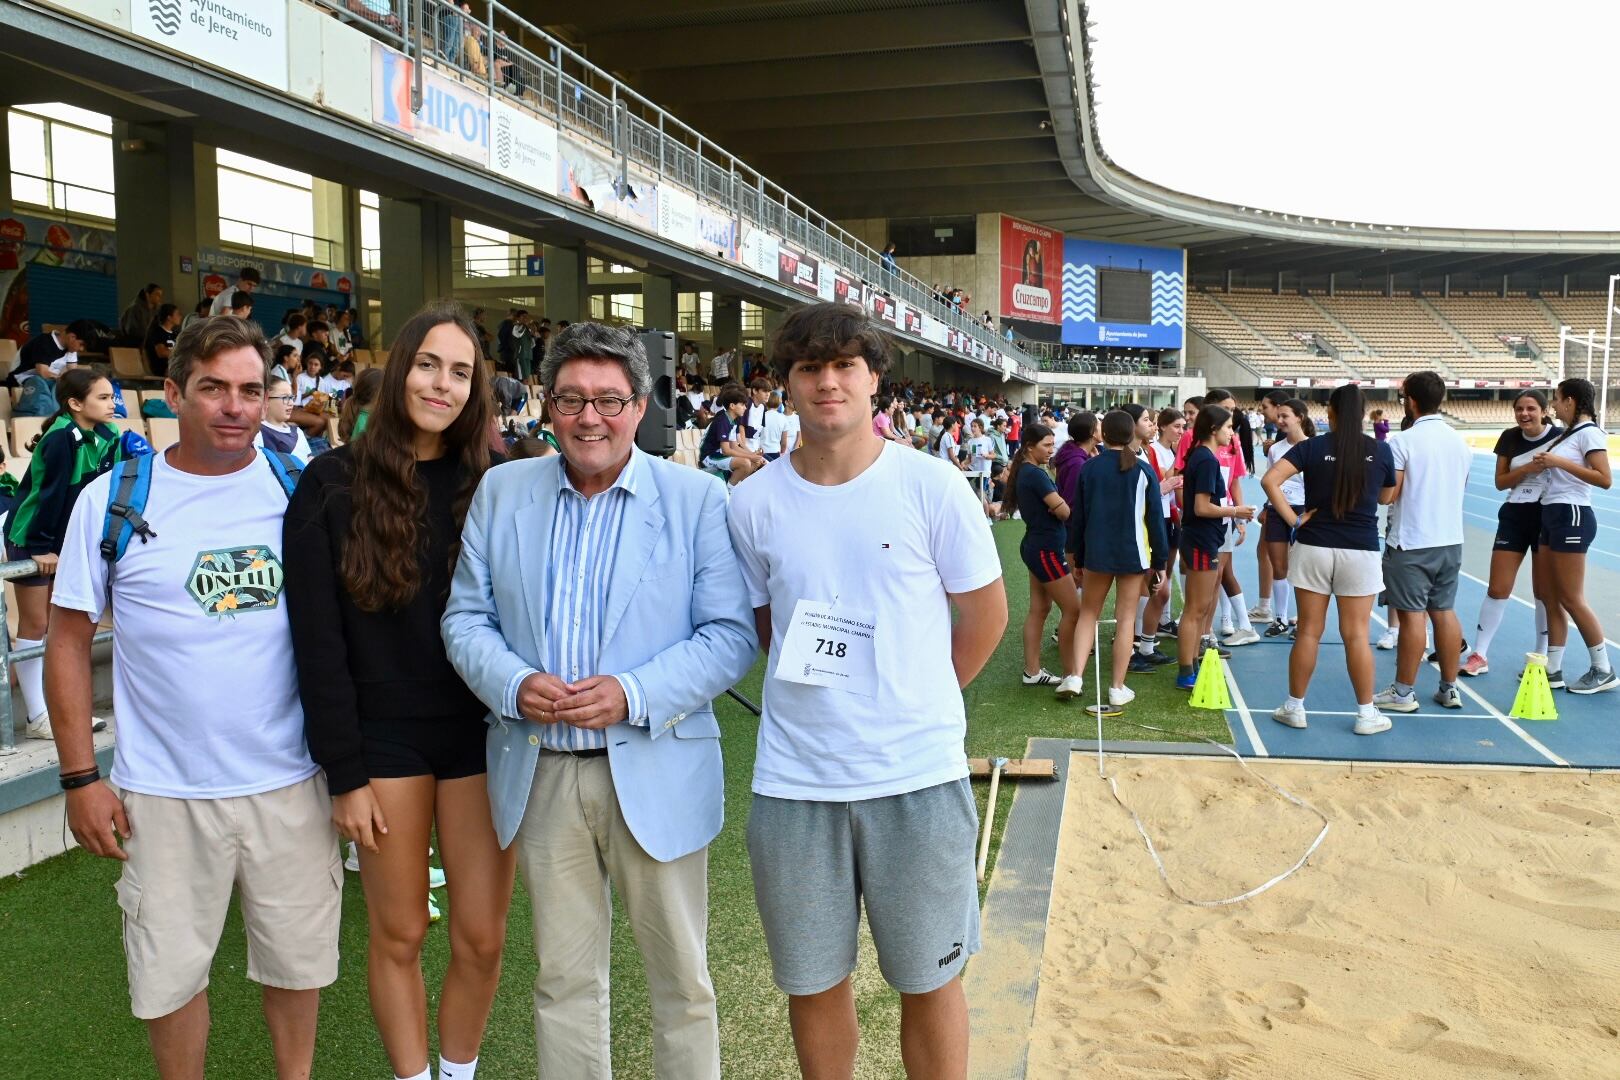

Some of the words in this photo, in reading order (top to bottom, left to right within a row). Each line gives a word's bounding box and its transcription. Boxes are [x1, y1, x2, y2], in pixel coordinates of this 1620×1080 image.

[190, 9, 205, 27] de
[208, 15, 238, 41] Jerez
[1015, 289, 1049, 310] Cruzcampo
[827, 615, 856, 626] ATLETISMO
[815, 638, 847, 658] 718
[938, 947, 961, 968] PUMA
